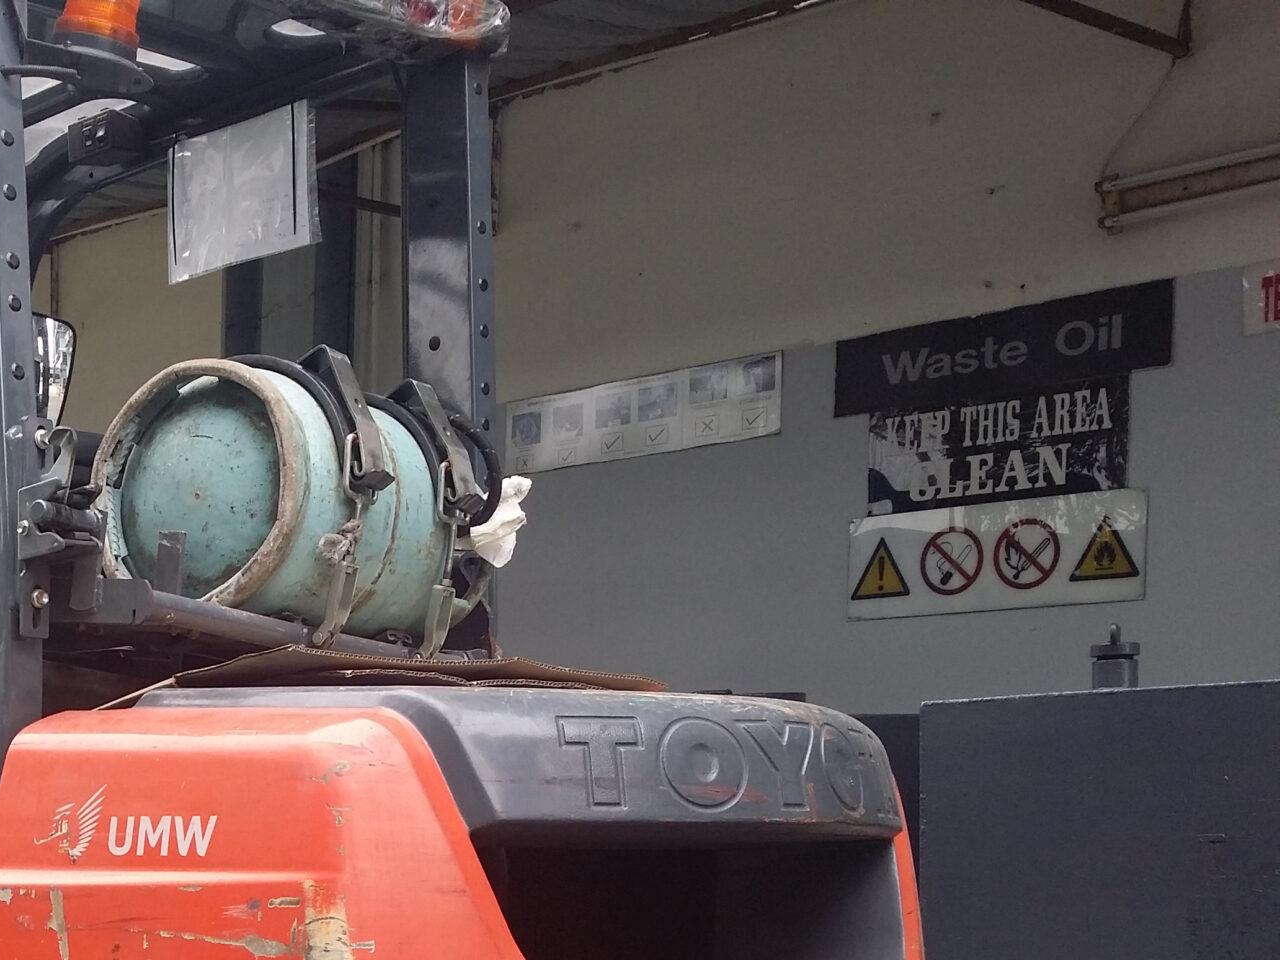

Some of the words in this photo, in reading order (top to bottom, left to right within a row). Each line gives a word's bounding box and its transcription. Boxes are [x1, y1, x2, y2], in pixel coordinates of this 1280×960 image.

[882, 336, 1028, 385] Waste
[1055, 314, 1122, 356] Oil
[960, 400, 1020, 447] THIS
[1030, 387, 1113, 439] AREA
[909, 443, 1071, 502] CLEAN
[554, 714, 900, 818] TOYO
[108, 815, 218, 857] UMW
